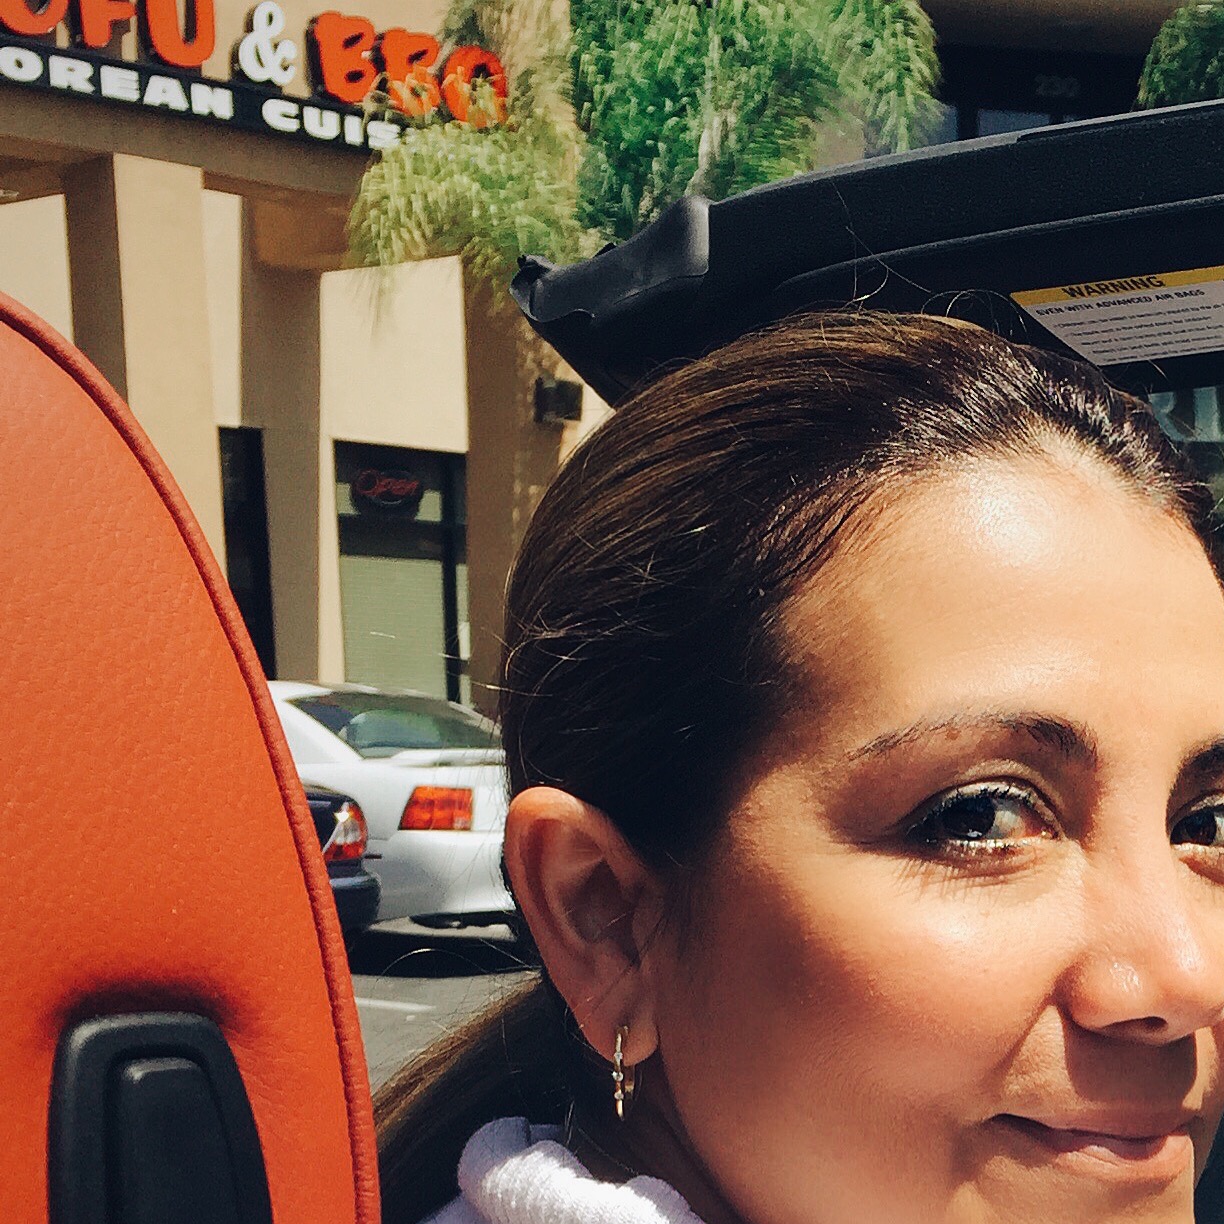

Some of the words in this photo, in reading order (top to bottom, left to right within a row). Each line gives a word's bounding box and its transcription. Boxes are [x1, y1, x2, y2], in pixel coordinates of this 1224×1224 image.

[238, 1, 297, 85] &
[0, 46, 235, 119] OREAN
[1035, 306, 1065, 316] EVEN
[1065, 302, 1093, 312] WITH
[1095, 295, 1153, 308] ADVANCED
[1155, 292, 1175, 302] AIR
[1177, 289, 1205, 299] BAGS
[1062, 276, 1166, 298] WARNING
